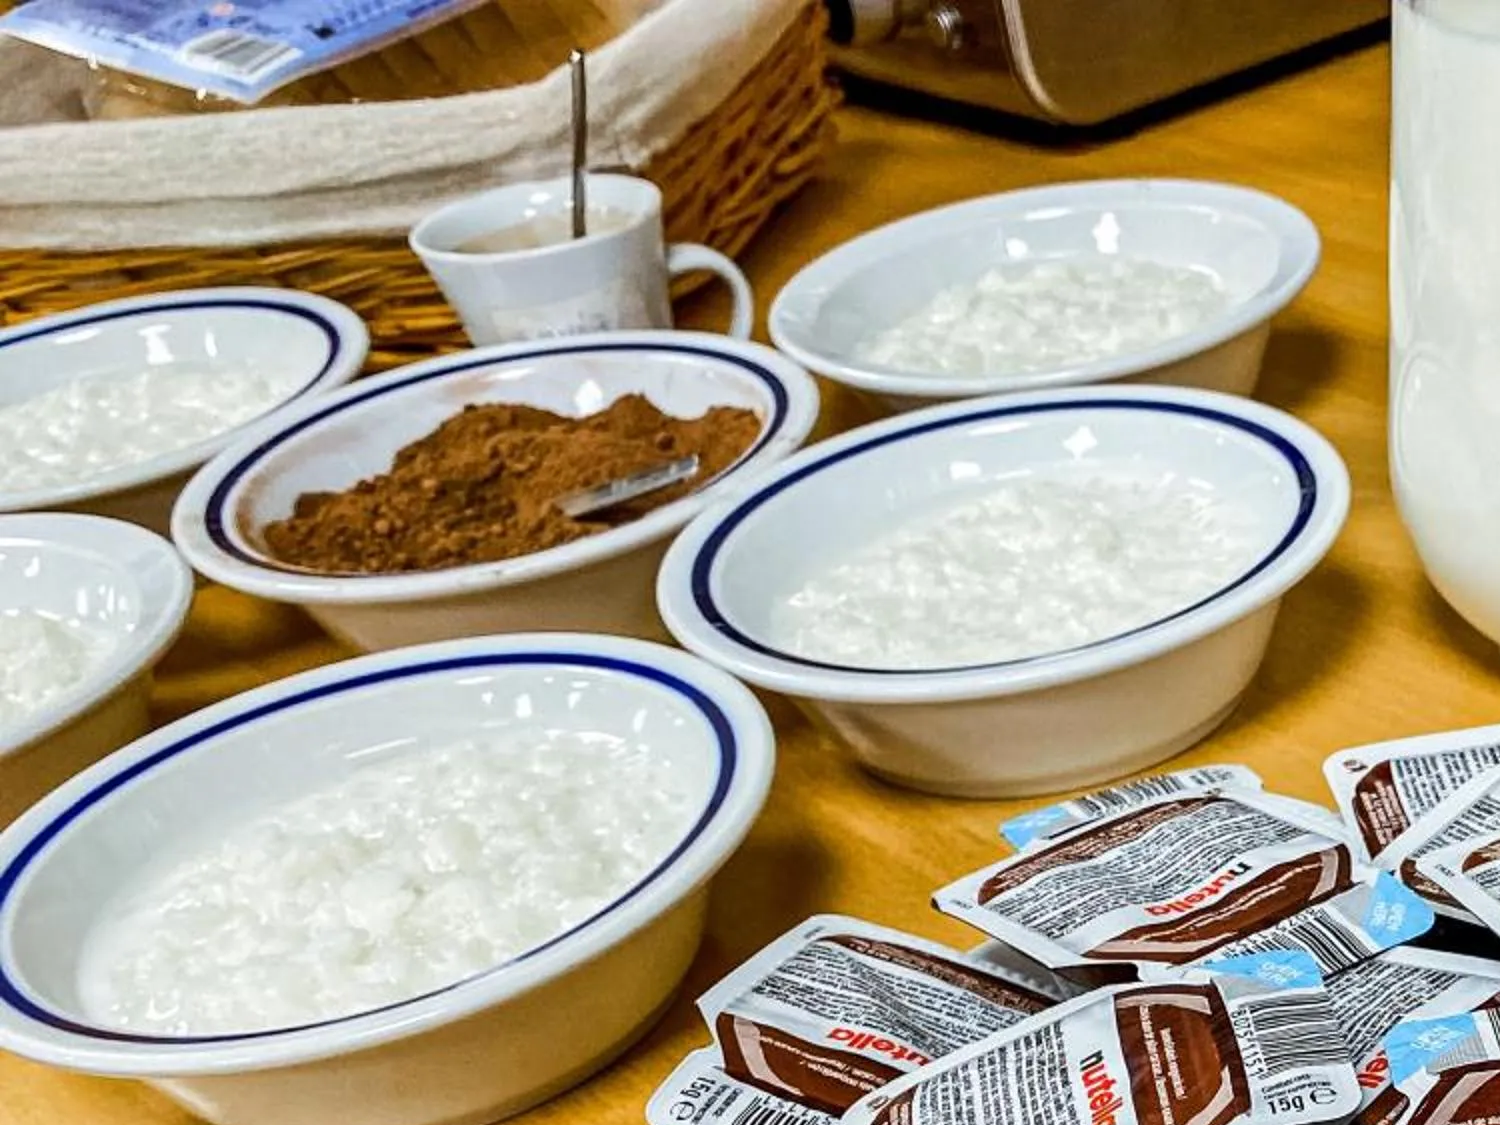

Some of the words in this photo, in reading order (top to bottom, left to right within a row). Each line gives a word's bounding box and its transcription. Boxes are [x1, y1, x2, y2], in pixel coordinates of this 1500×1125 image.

[1144, 861, 1254, 918] nutella
[829, 1025, 931, 1067] utella
[1267, 1093, 1304, 1114] 15g
